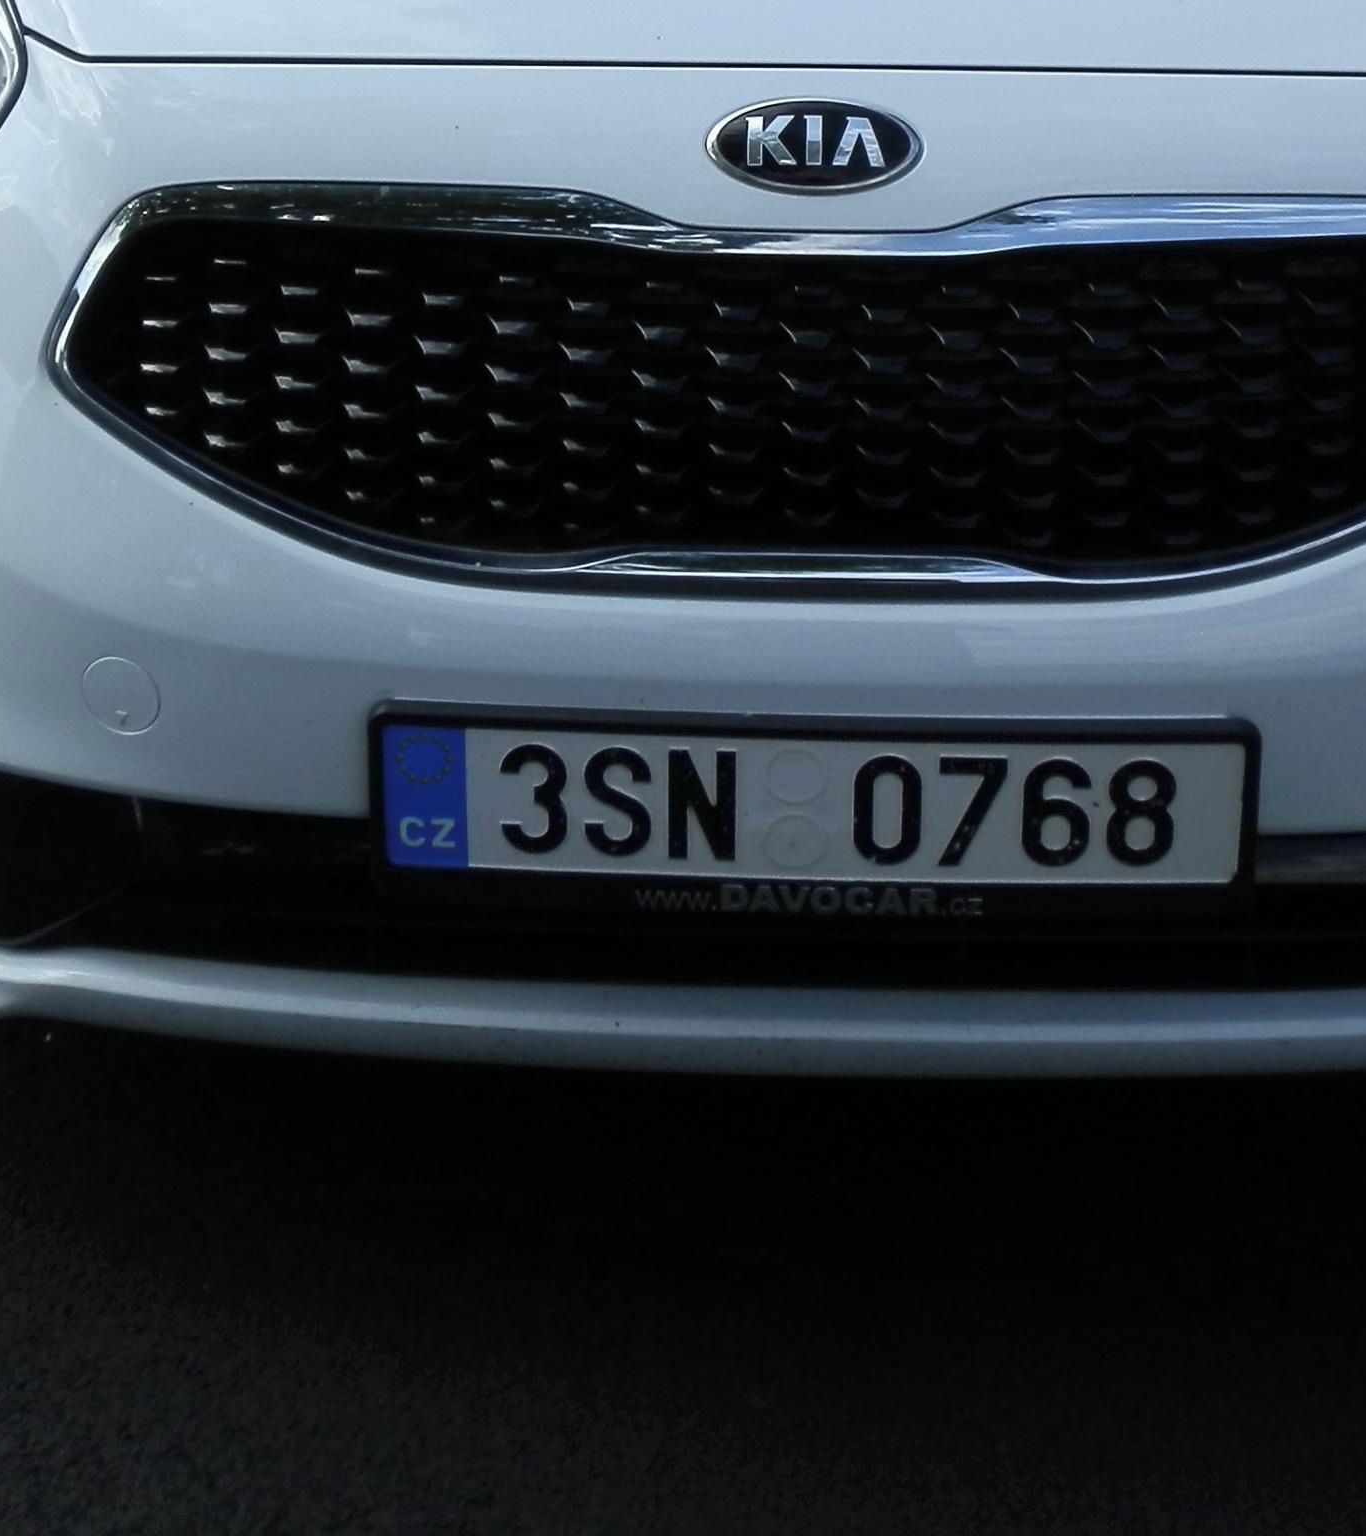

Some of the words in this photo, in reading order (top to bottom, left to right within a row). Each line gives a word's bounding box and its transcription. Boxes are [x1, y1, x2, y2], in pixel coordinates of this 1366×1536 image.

[746, 115, 886, 167] KIA
[500, 743, 736, 861] 3SN
[852, 754, 1177, 867] 0768
[399, 817, 456, 848] CZ
